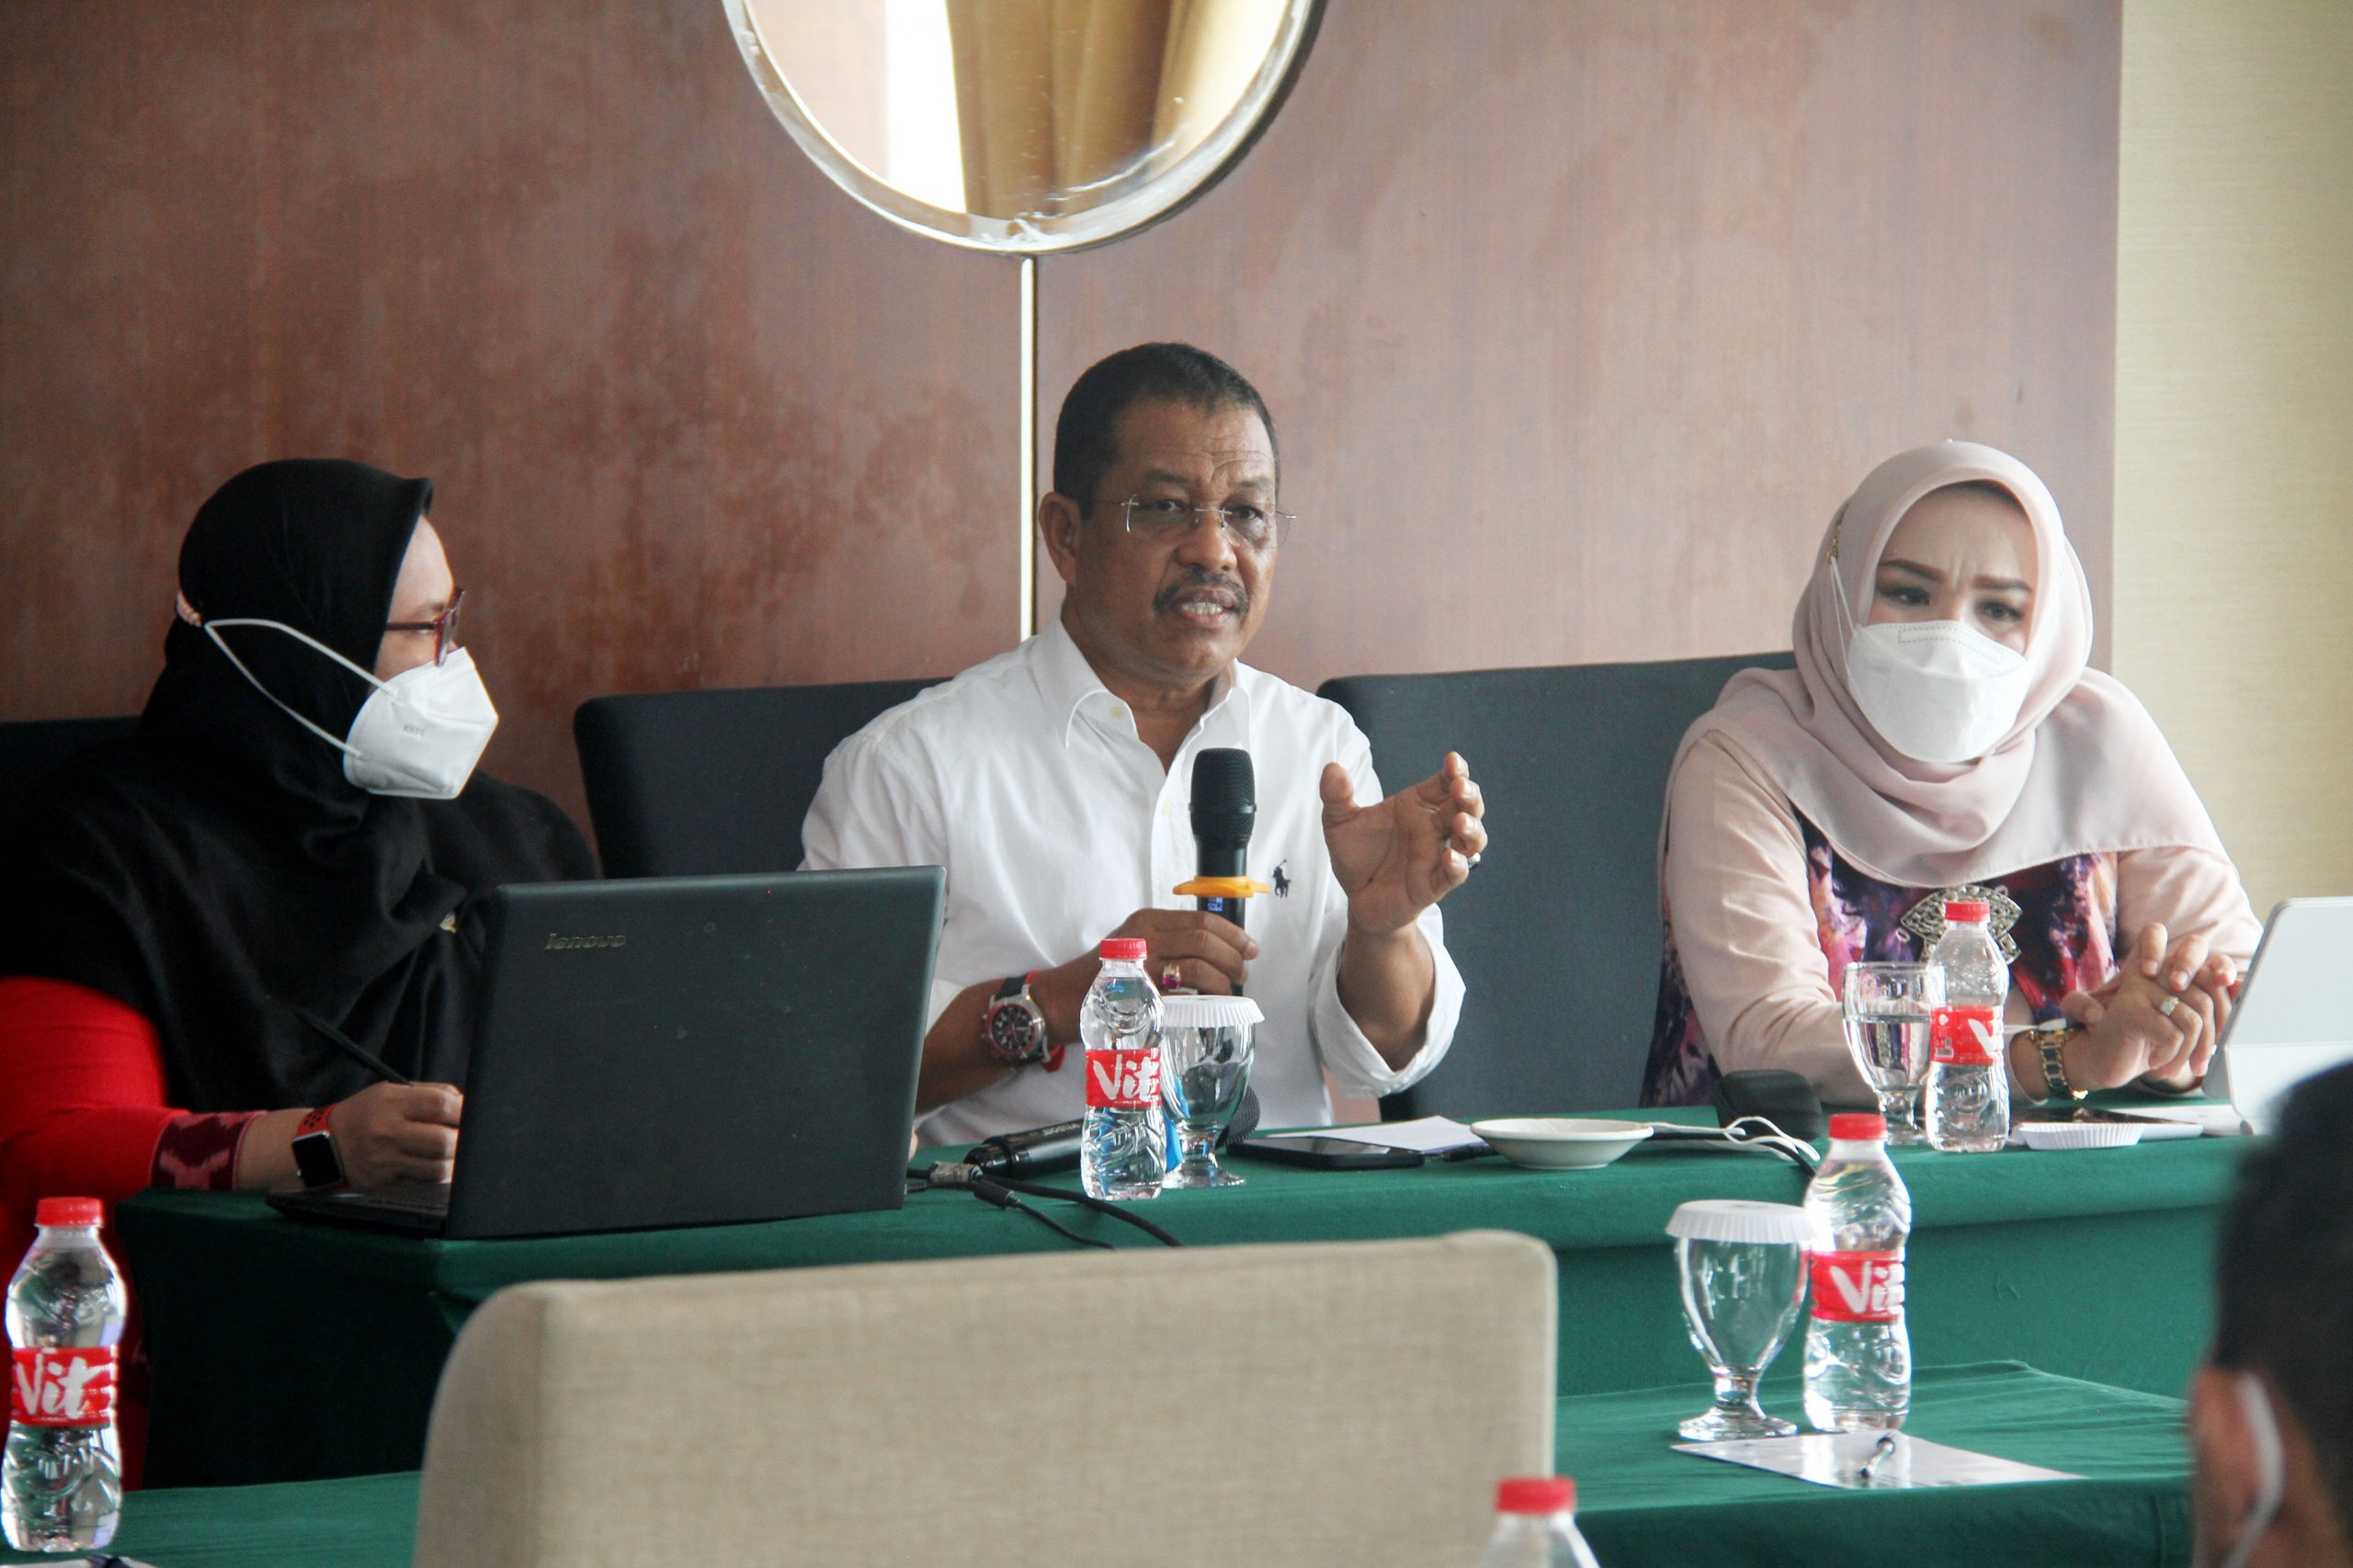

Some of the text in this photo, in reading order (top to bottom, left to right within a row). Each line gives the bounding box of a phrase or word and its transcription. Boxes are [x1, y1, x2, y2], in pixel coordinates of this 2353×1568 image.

[544, 933, 626, 949] lenovo
[1093, 1053, 1159, 1102] Vit
[17, 1353, 112, 1420] Vit
